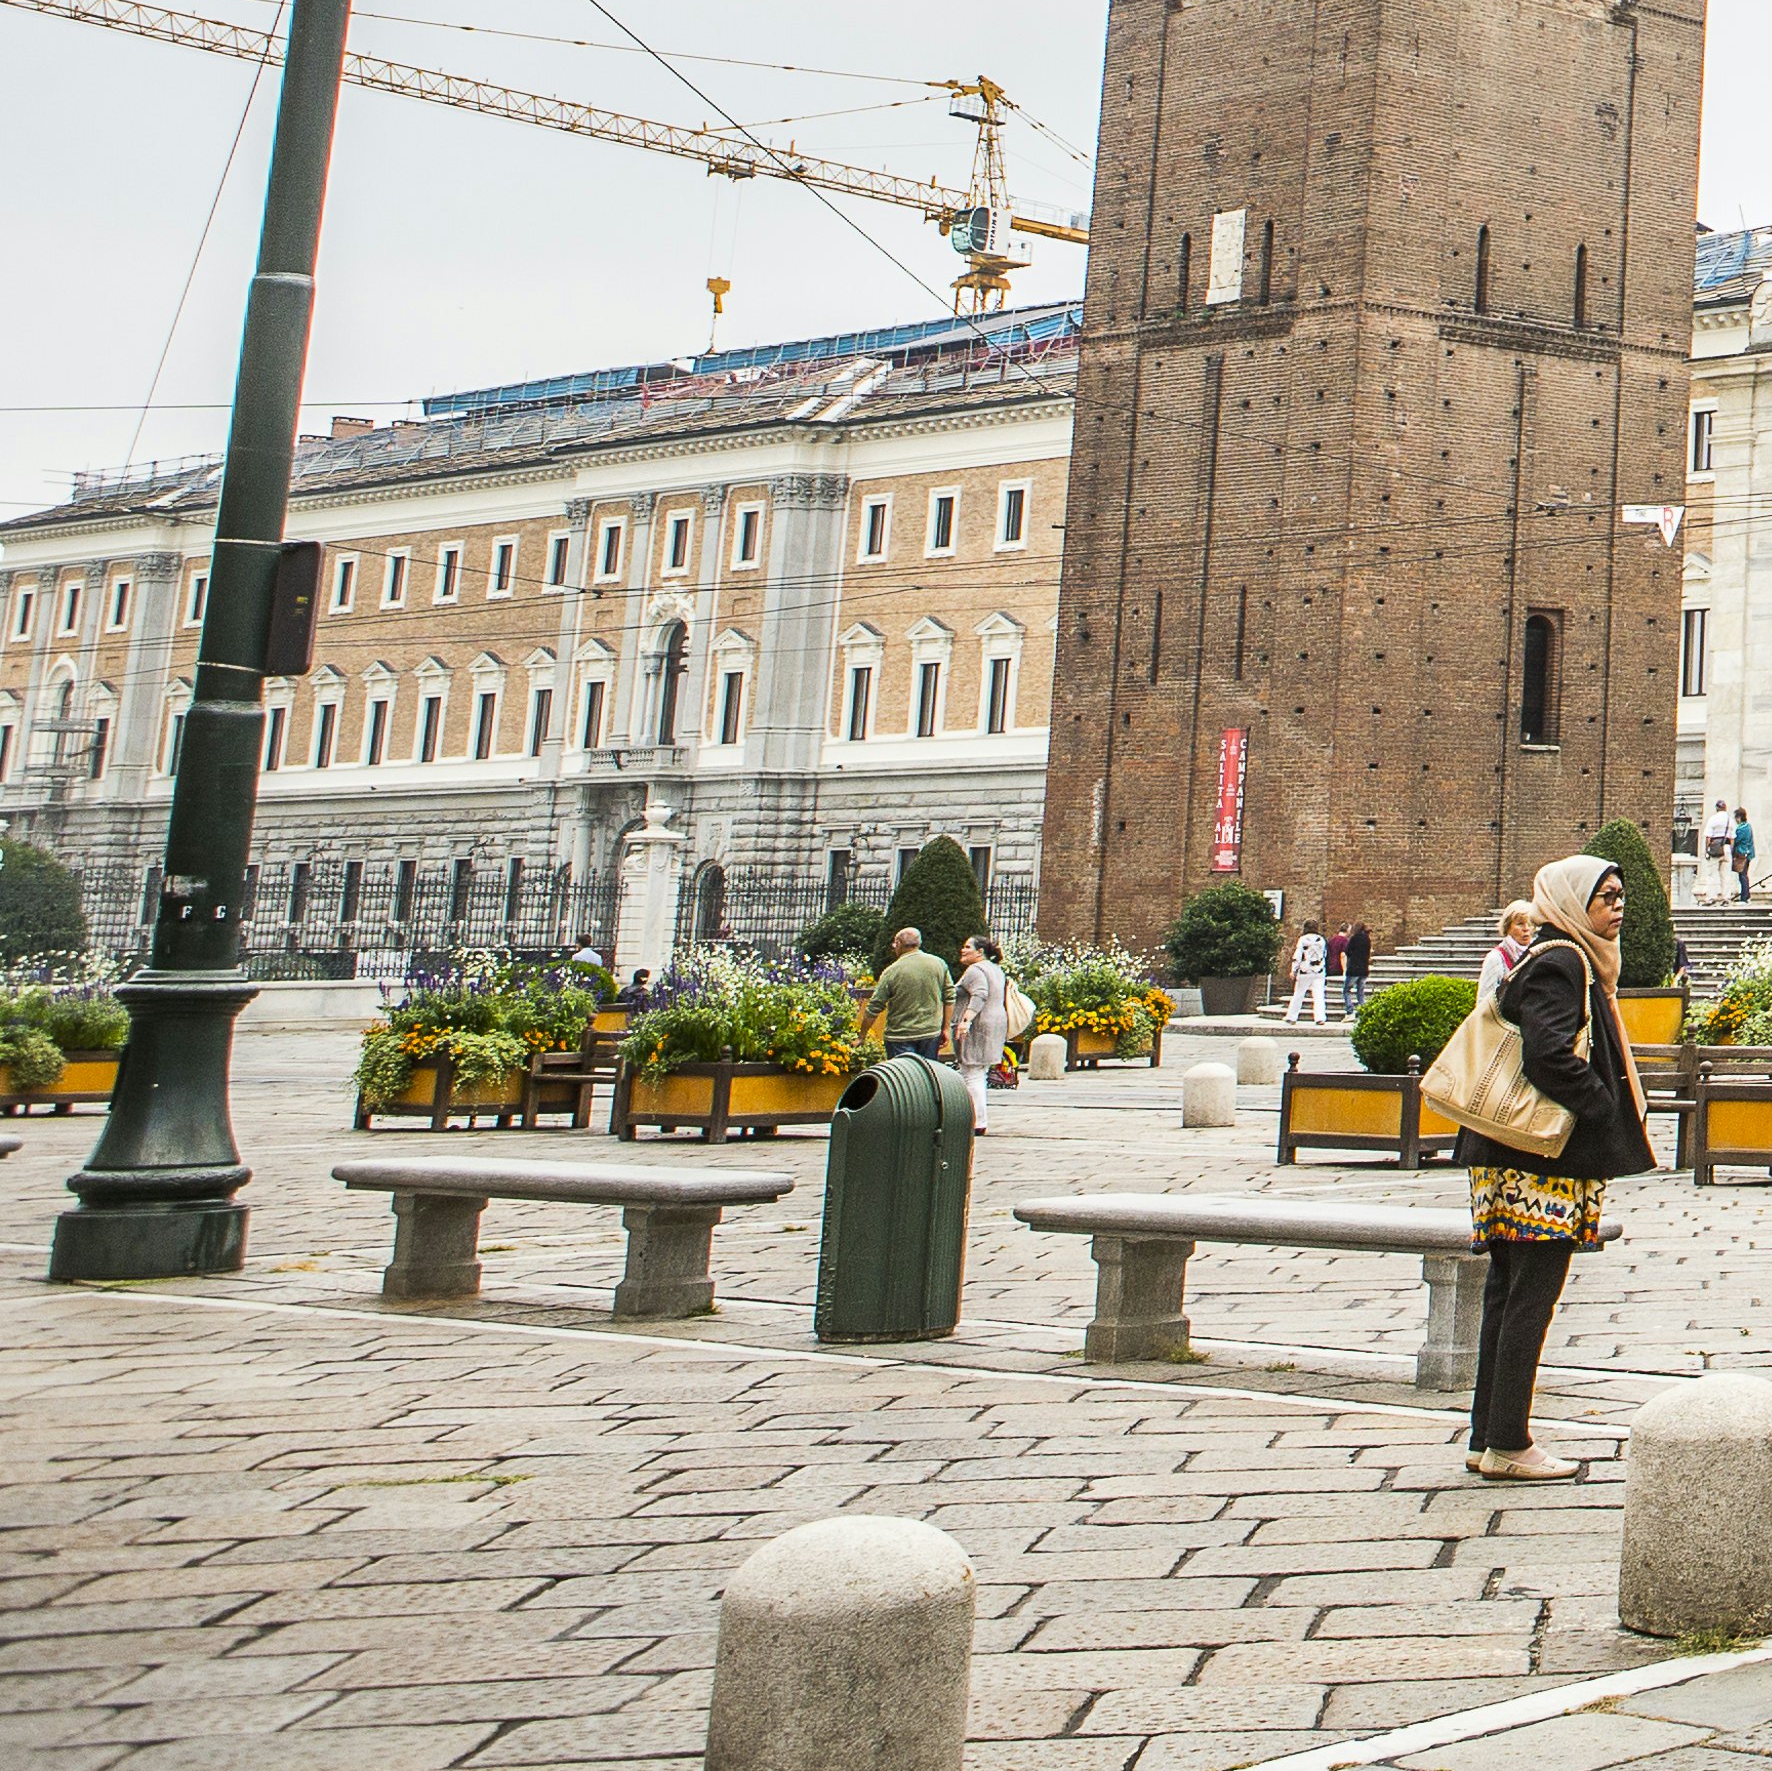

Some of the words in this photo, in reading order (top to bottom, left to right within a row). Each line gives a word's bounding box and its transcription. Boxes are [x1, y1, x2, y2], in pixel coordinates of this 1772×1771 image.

[1664, 508, 1674, 531] R
[1216, 739, 1227, 808] SALITA
[1233, 739, 1247, 844] CAMPANILE
